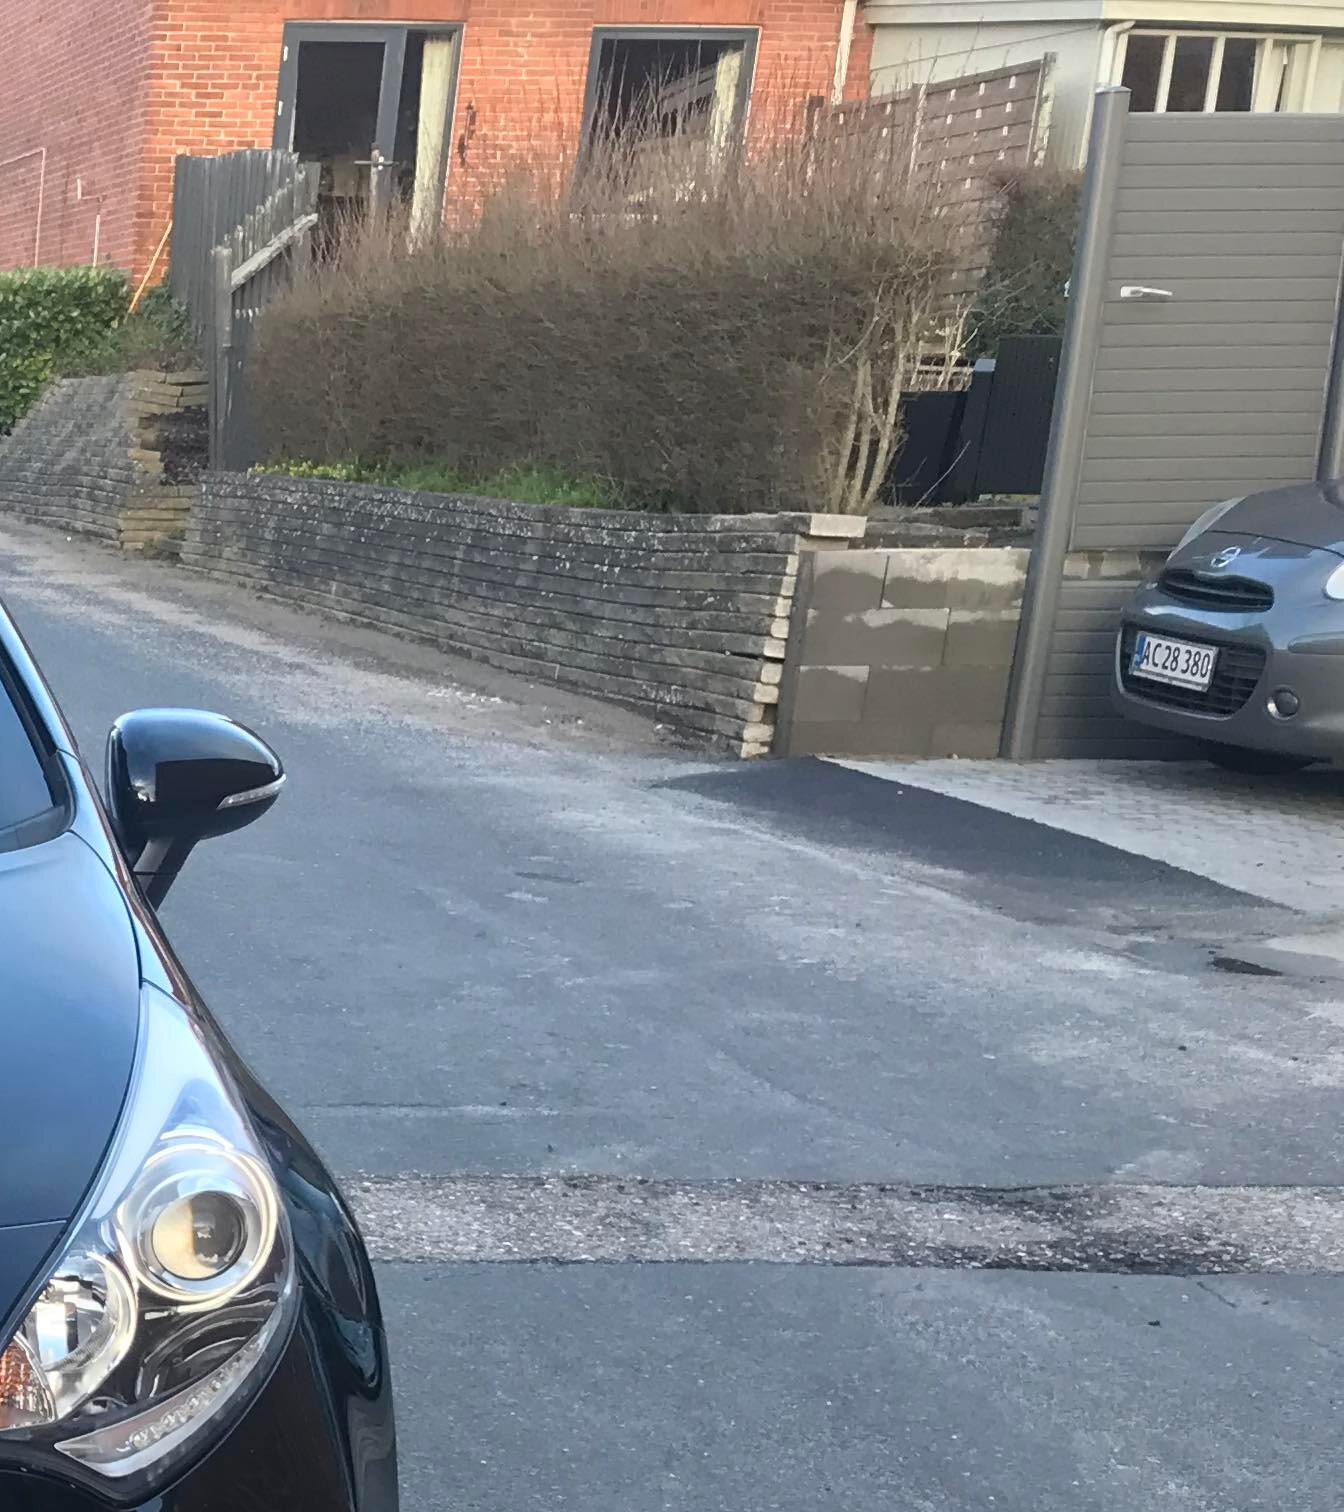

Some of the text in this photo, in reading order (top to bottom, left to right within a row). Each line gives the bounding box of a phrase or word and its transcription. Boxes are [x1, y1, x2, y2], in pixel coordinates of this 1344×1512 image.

[1142, 641, 1211, 679] AC 28 380
